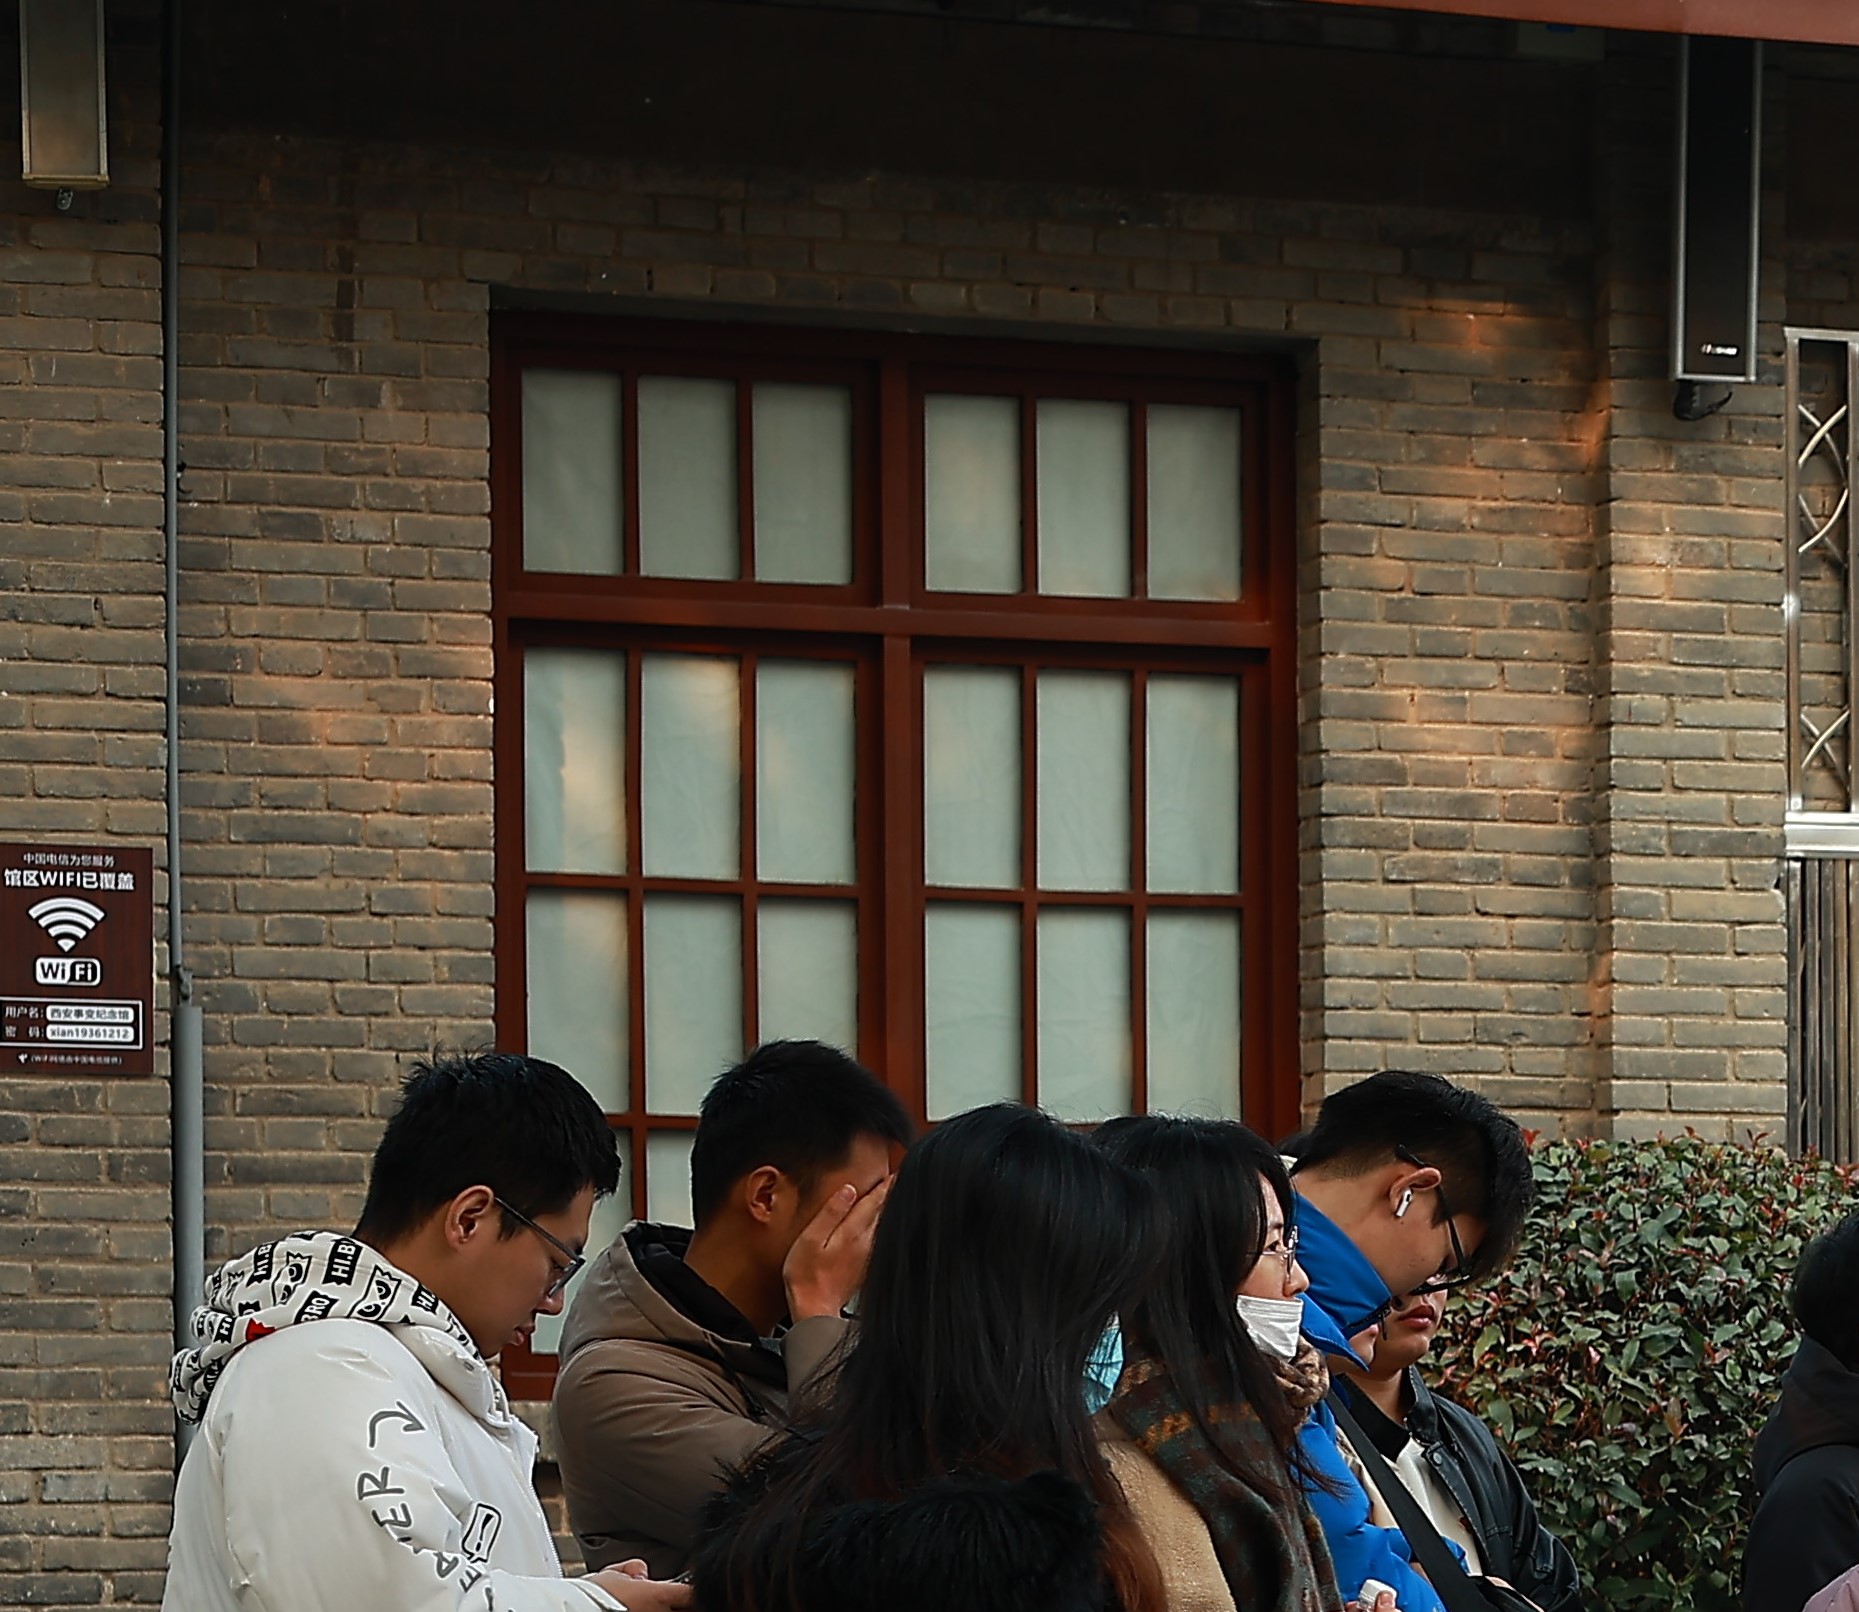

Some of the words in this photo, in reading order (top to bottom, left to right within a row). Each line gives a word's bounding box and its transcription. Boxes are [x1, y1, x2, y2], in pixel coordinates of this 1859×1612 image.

[4, 868, 135, 891] 馆区WIFI已覆盖
